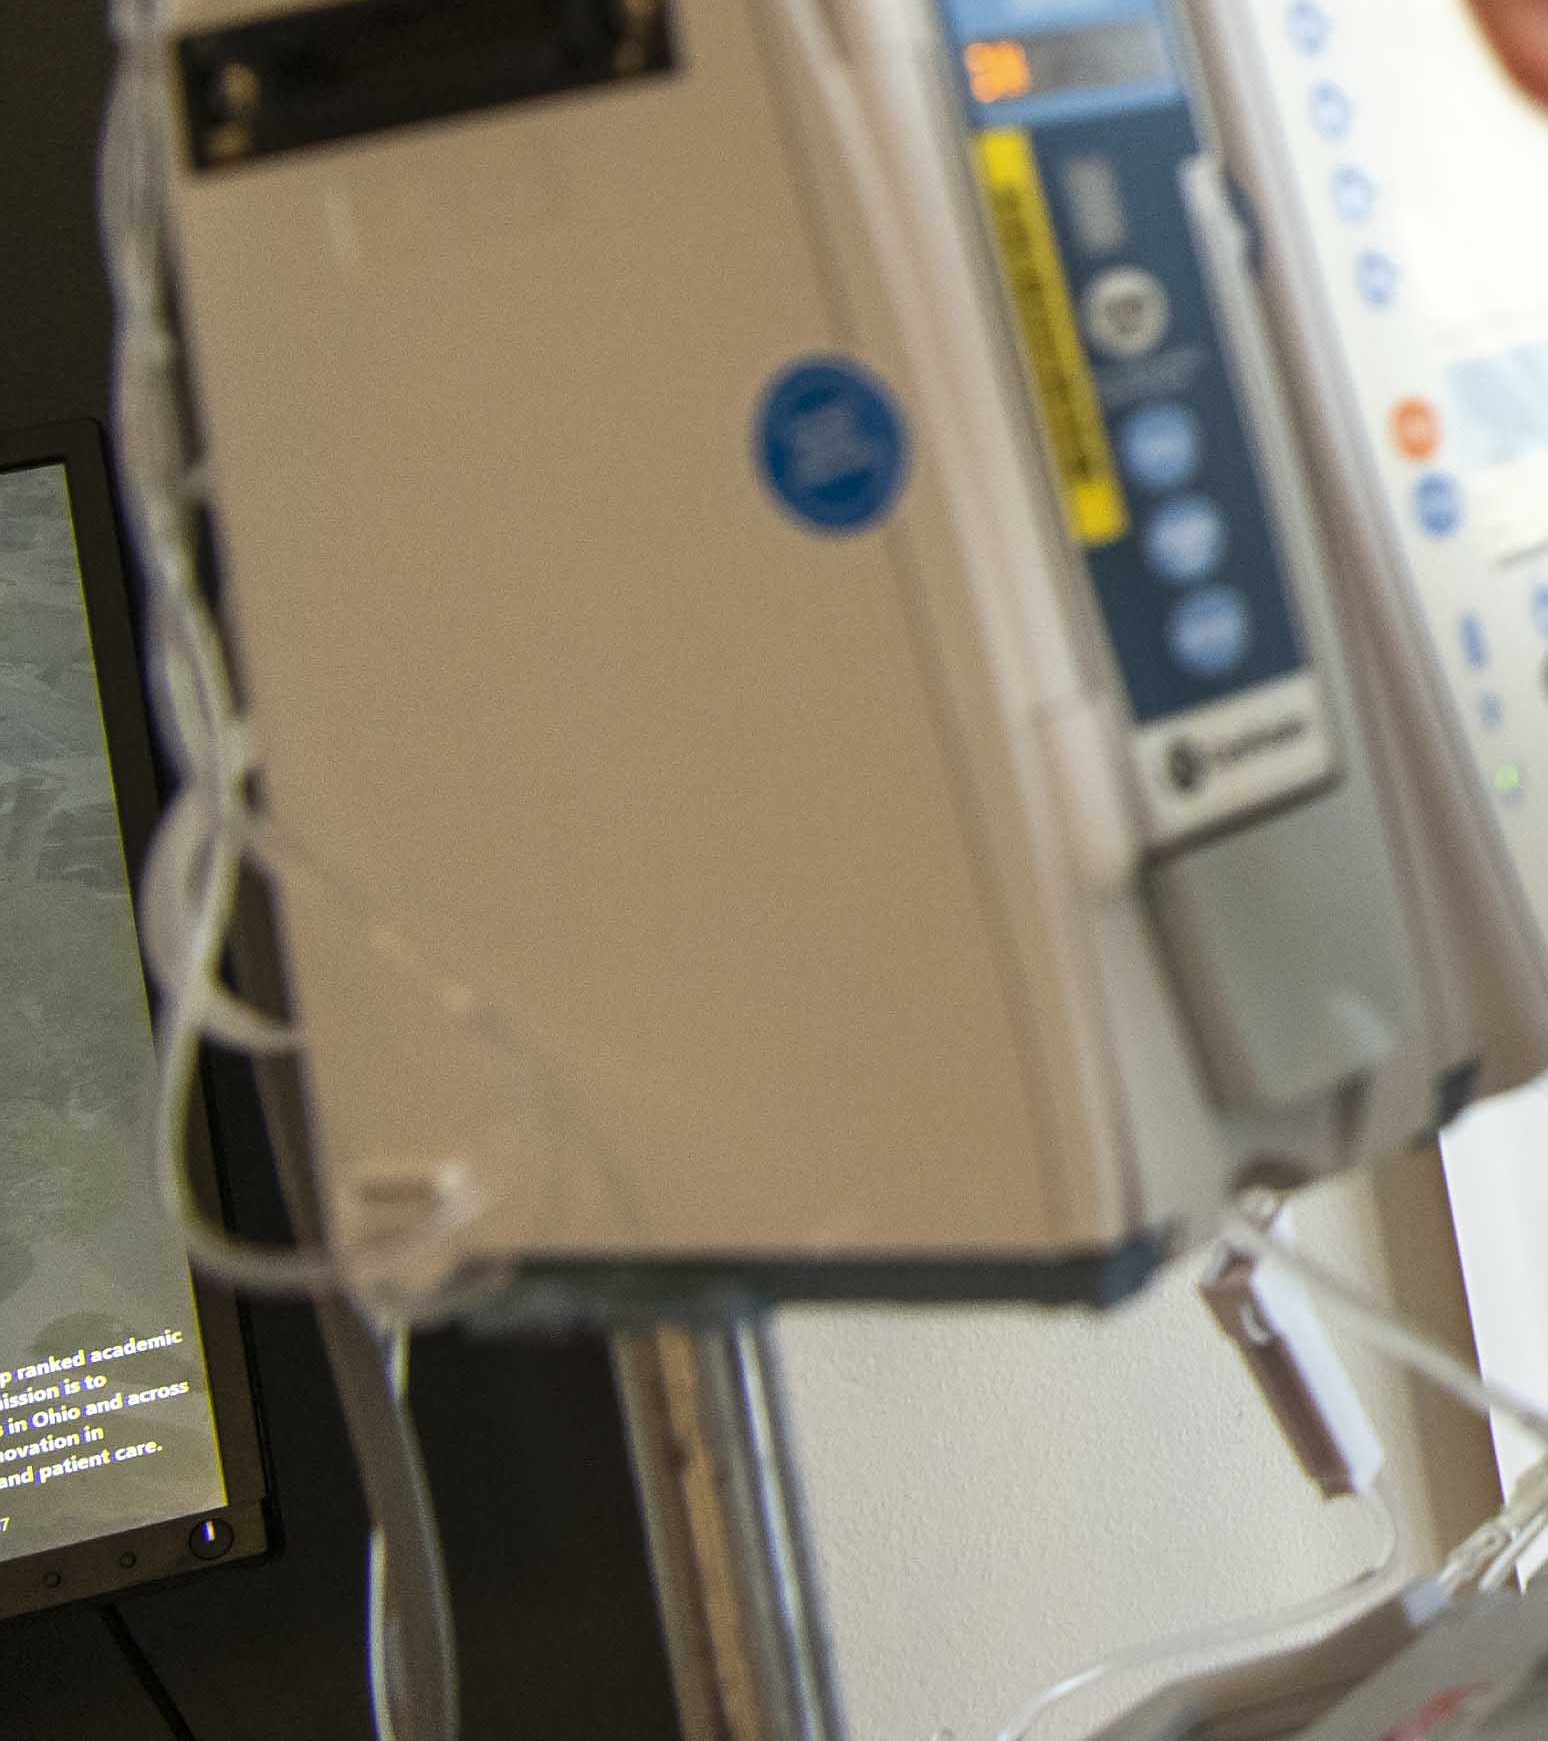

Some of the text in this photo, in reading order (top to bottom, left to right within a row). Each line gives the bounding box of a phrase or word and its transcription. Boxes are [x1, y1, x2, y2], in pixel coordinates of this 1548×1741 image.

[15, 1350, 86, 1380] ranked
[88, 1329, 184, 1365] academic
[0, 1374, 108, 1410] ission is to
[6, 1417, 28, 1435] in
[31, 1405, 81, 1429] Ohio
[85, 1393, 124, 1417] and
[126, 1380, 190, 1407] across
[82, 1425, 105, 1444] in
[0, 1440, 164, 1490] and patient care.
